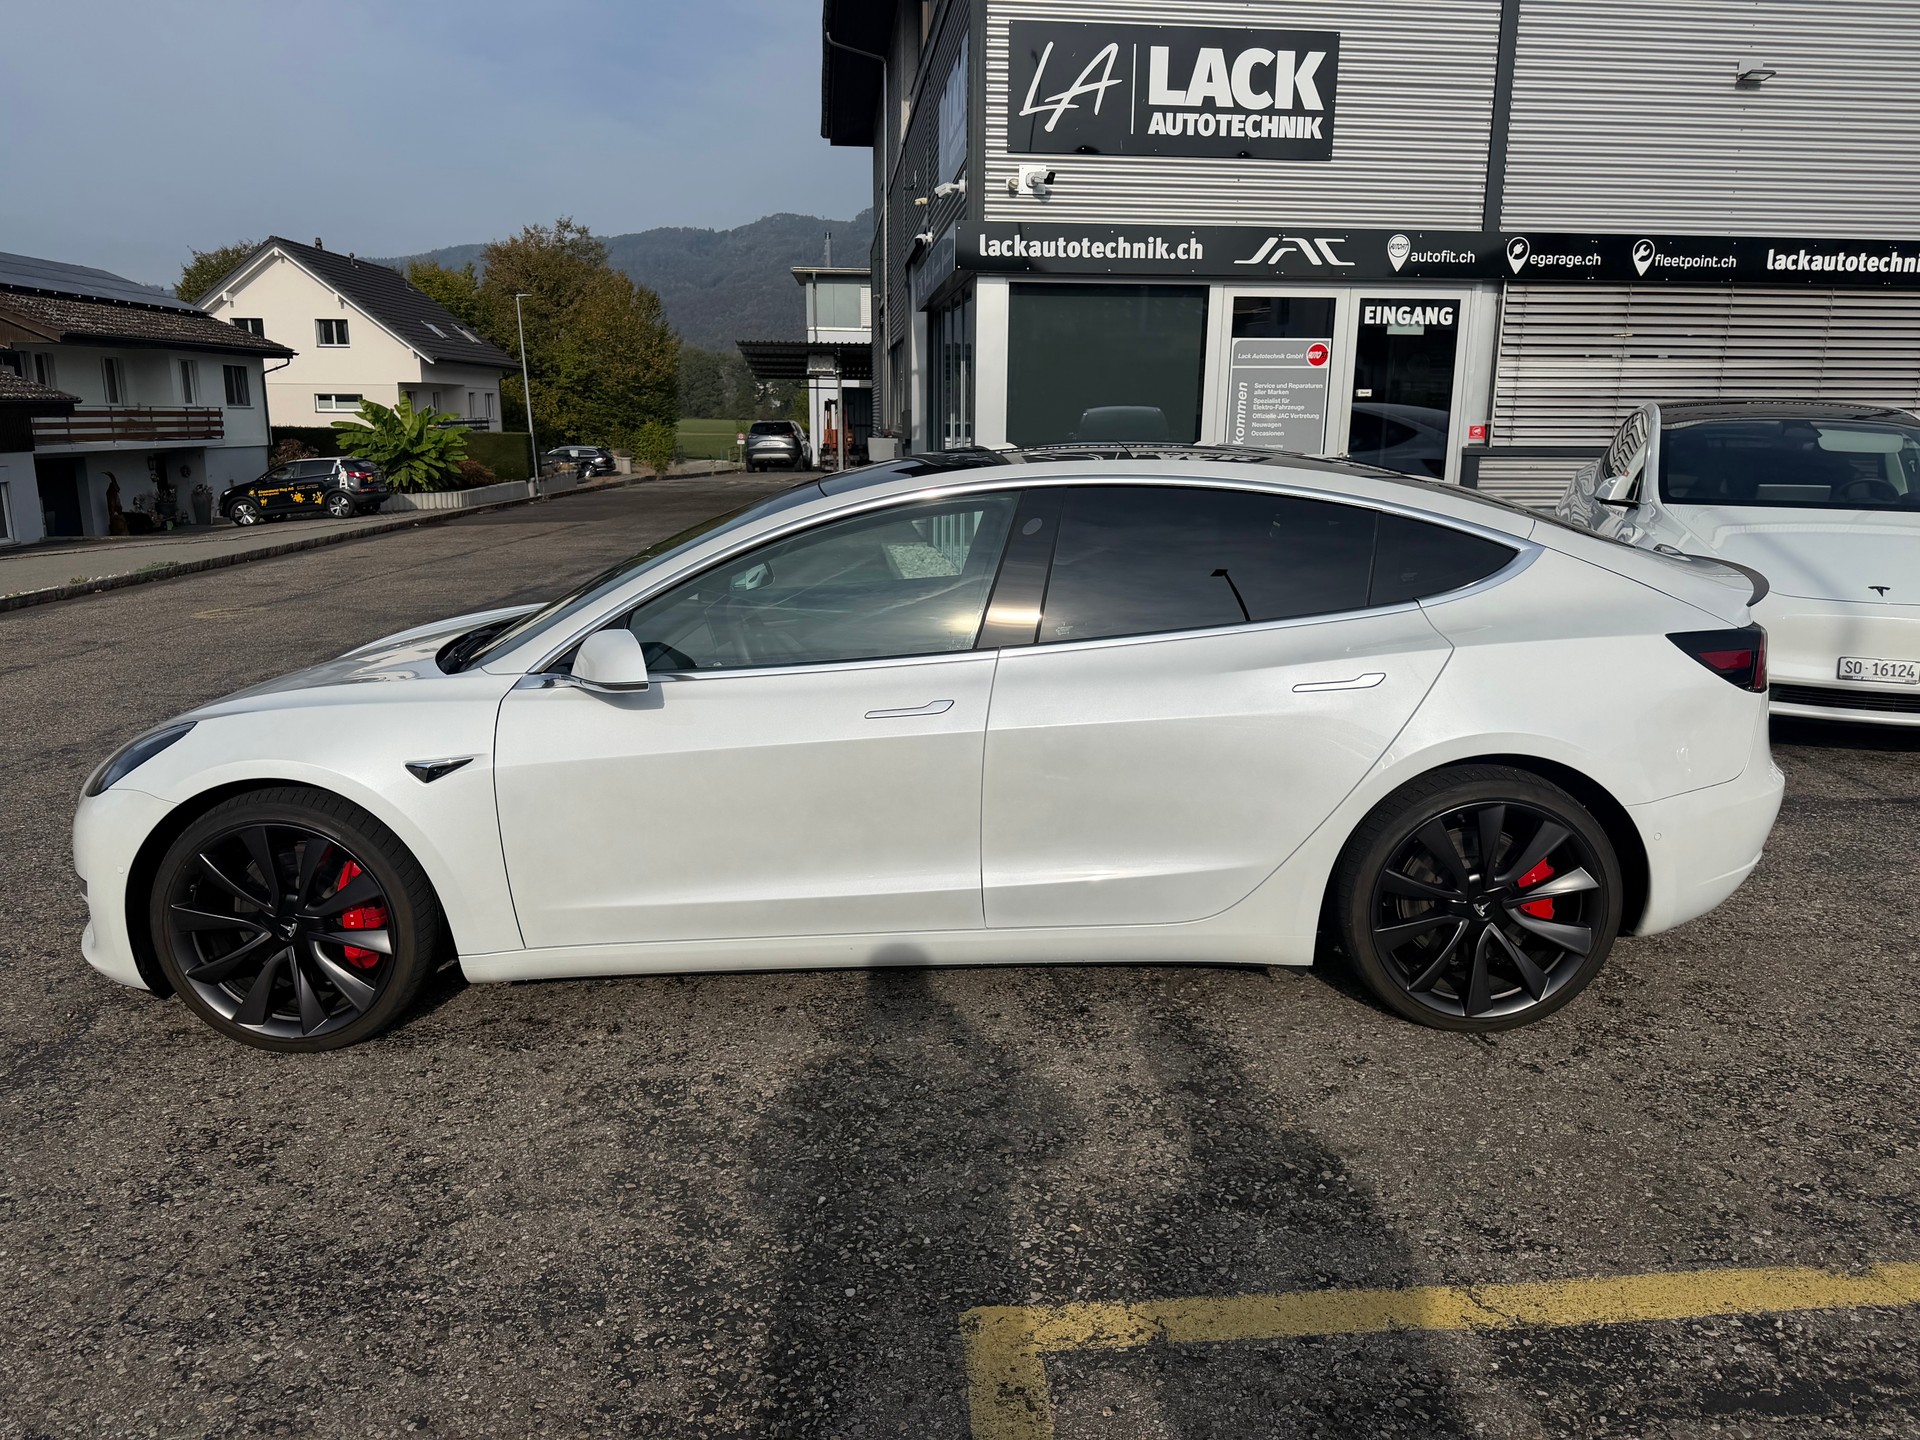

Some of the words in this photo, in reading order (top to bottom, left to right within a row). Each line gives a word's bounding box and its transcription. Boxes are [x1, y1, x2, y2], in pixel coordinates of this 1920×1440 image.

[1148, 46, 1327, 111] LACK
[1147, 112, 1324, 139] AUTOTECHNIK
[979, 233, 1204, 260] lackautotechnik.ch
[1410, 249, 1476, 264] autofit.ch
[1529, 252, 1602, 268] egarage.ch
[1654, 253, 1737, 269] fleetpoint.ch
[1363, 305, 1454, 326] EINGANG
[1844, 660, 1862, 674] SO
[1872, 662, 1916, 679] 16124
